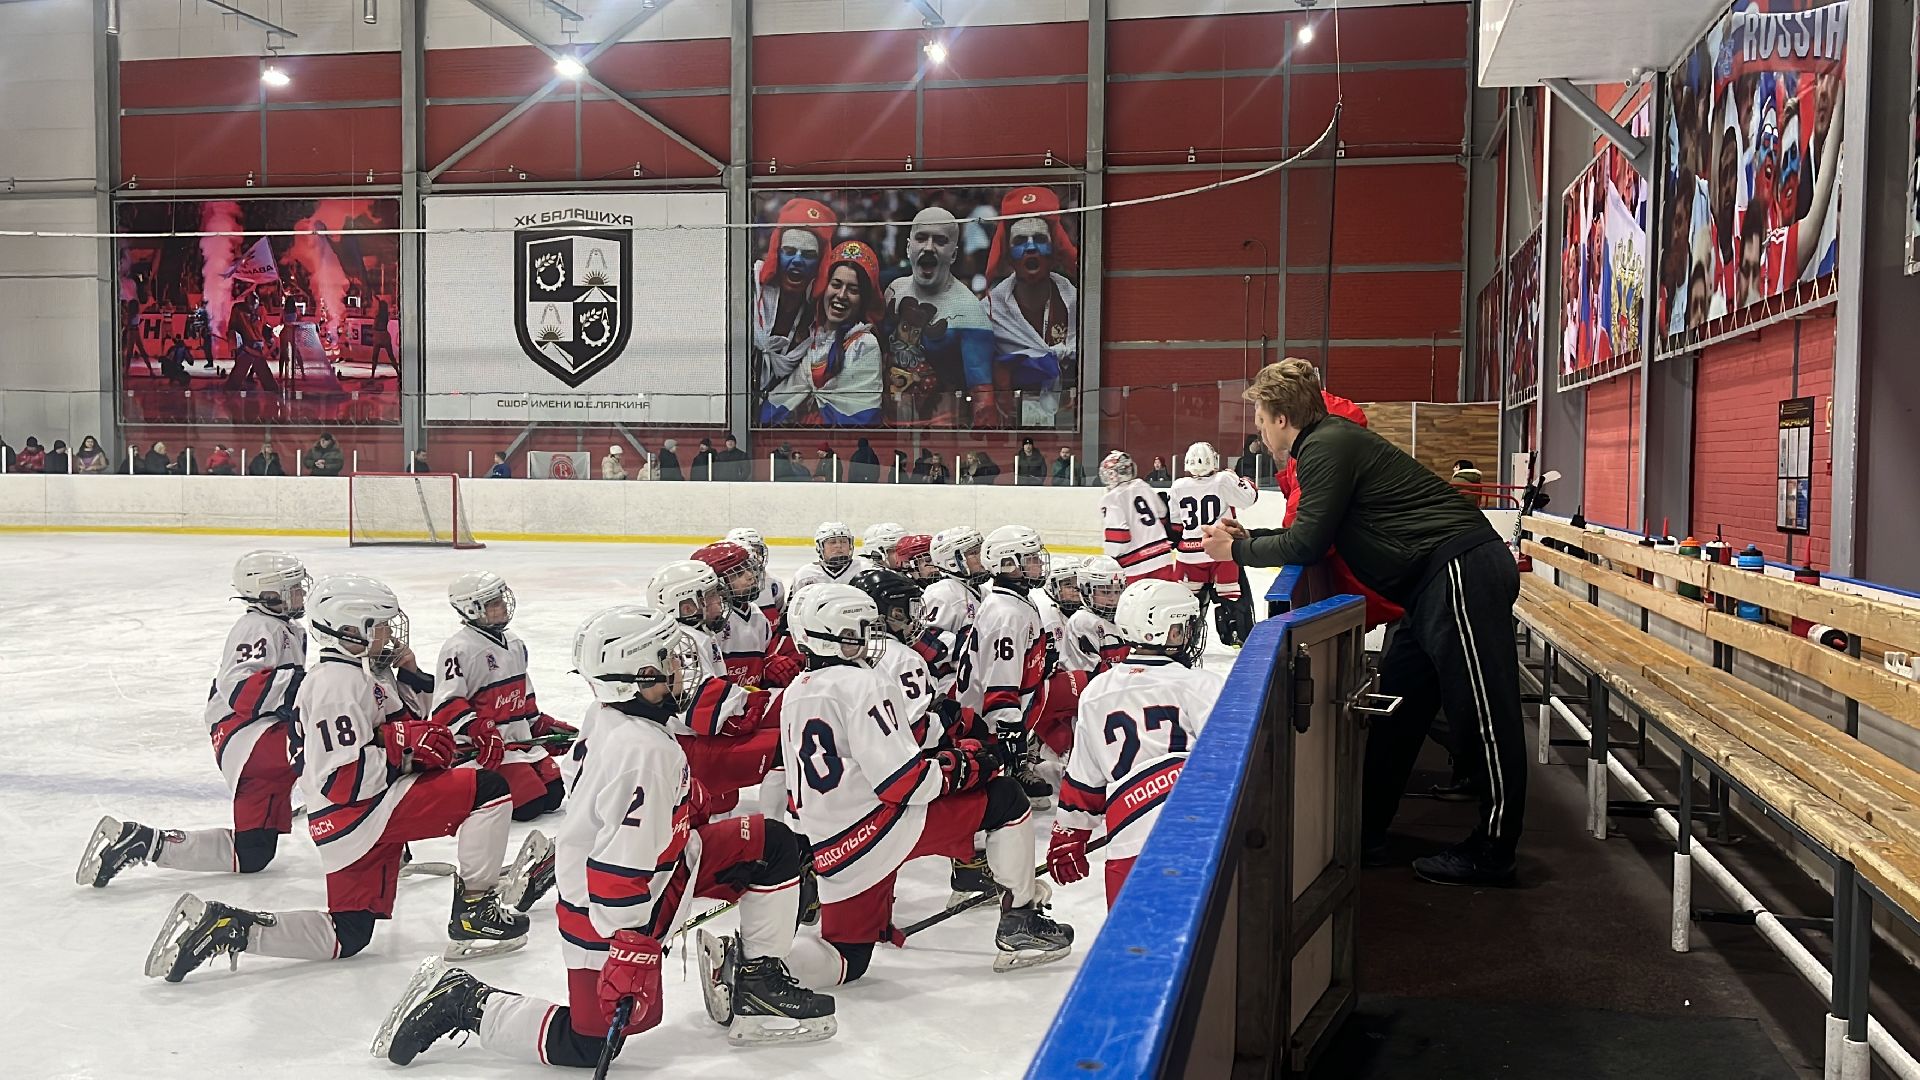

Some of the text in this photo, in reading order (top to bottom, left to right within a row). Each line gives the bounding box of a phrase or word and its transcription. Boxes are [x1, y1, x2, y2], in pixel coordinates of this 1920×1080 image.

[514, 208, 633, 227] ХК БАЛАШИХА
[497, 400, 528, 408] СШОР
[531, 400, 571, 408] ИМЕНИ
[1134, 495, 1156, 527] 9
[1179, 494, 1221, 531] 30
[236, 637, 267, 664] 33
[316, 715, 357, 753] 18
[1103, 704, 1190, 782] 27
[621, 786, 645, 828] 2
[779, 1002, 801, 1010] CCM
